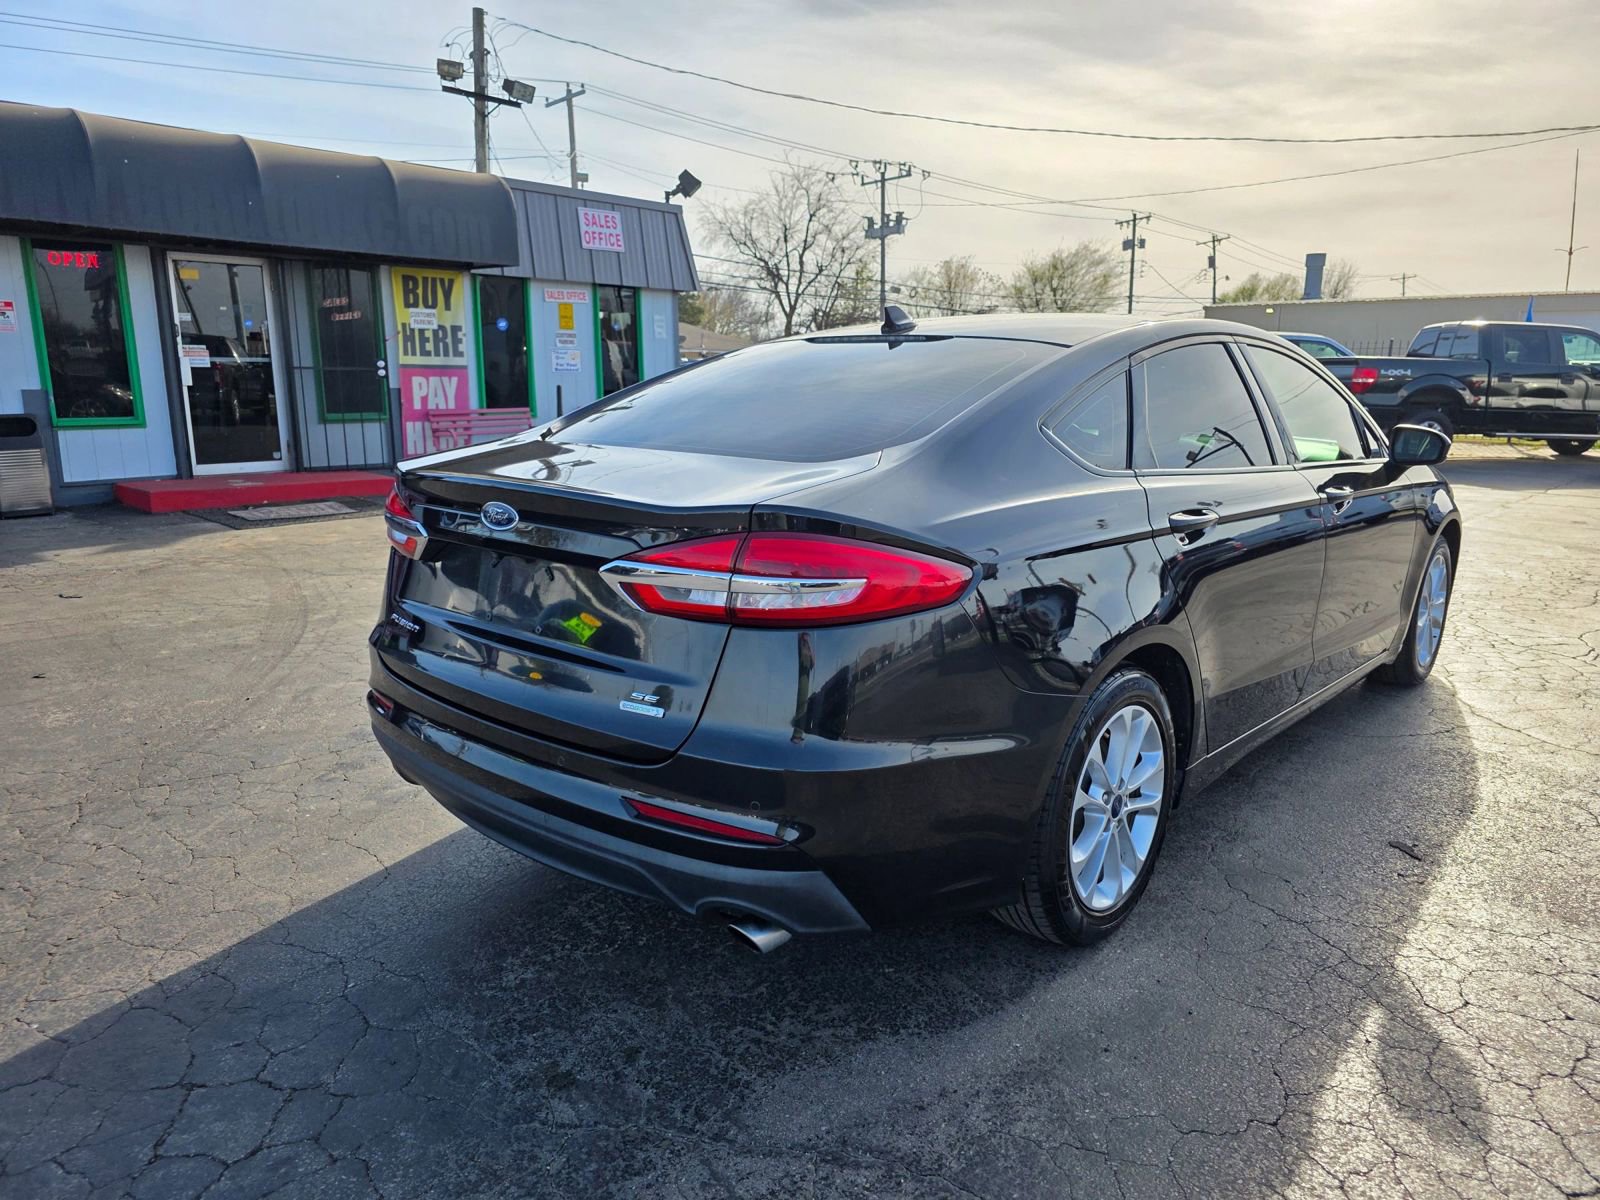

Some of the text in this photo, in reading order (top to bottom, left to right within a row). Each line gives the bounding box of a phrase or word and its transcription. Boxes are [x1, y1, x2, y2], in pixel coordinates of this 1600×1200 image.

[583, 212, 617, 230] SALES
[584, 231, 622, 248] OFFICE
[47, 251, 99, 269] OPEN
[402, 274, 454, 312] BUY
[546, 290, 587, 302] SALES OFFICE
[401, 322, 465, 358] HERE
[411, 376, 458, 409] PAY
[486, 507, 509, 523] Ford
[390, 613, 420, 633] FUSION
[630, 692, 661, 703] SE
